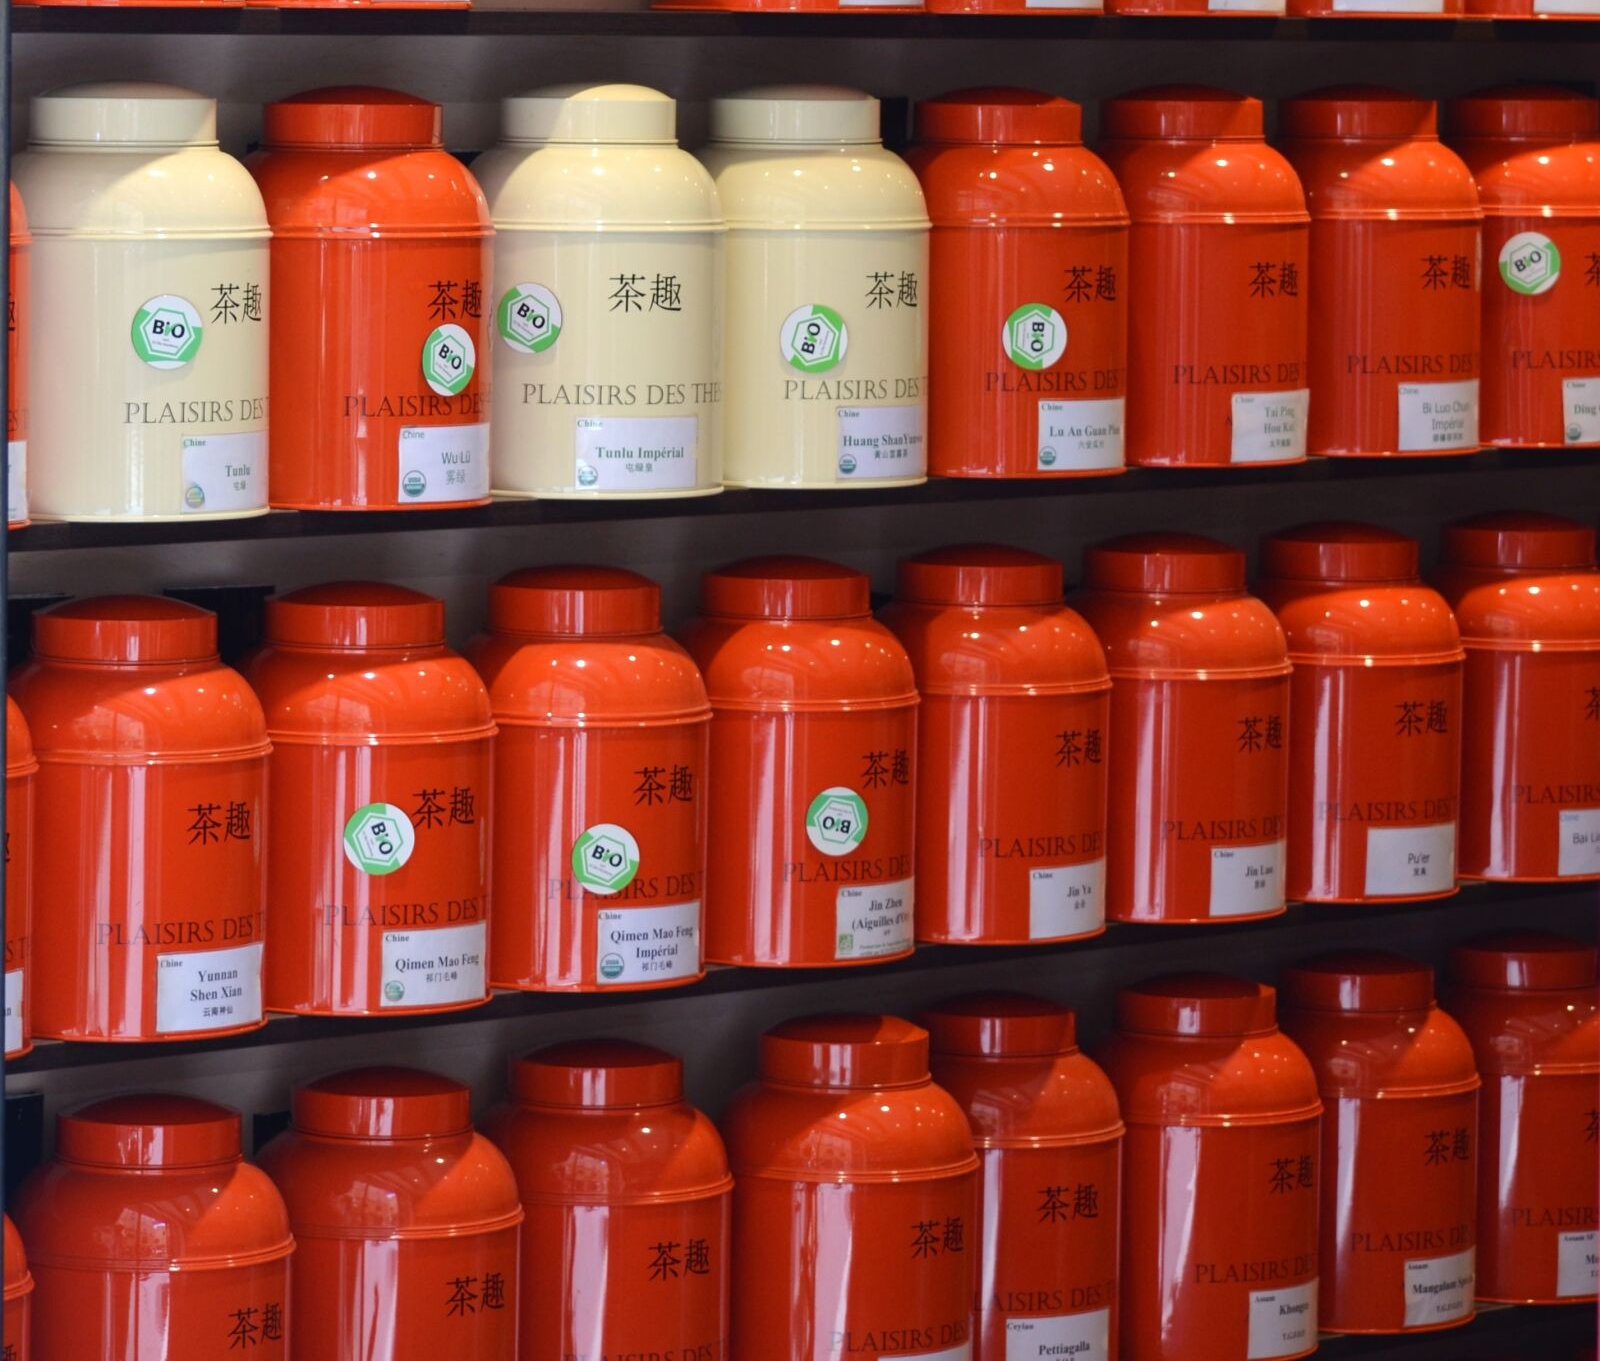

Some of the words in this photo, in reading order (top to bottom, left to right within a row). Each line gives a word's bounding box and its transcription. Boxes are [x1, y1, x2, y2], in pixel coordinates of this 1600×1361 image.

[1248, 261, 1299, 299] 茶趣
[1422, 255, 1470, 290] 茶趣
[608, 273, 683, 313] 茶趣
[1064, 265, 1116, 302] 茶趣
[210, 283, 262, 324] 茶趣
[428, 280, 482, 321] 茶趣
[1173, 365, 1271, 385] PLAISIRS
[1347, 355, 1443, 375] PLAISIRS
[783, 378, 887, 400] PLAISIRS
[985, 371, 1087, 392] PLAISIRS
[522, 384, 636, 406] PLAISIRS
[124, 399, 234, 424] PLAISIRS
[344, 393, 453, 418] PLAISIRS
[838, 409, 860, 419] Chine
[1041, 402, 1063, 412] Chine
[402, 429, 425, 440] Chine
[843, 434, 879, 449] Huang
[1049, 425, 1064, 438] Lu
[1067, 425, 1082, 438] An
[183, 437, 206, 448] Chine
[441, 451, 458, 465] Wu
[595, 446, 633, 459] Tunlu
[638, 445, 684, 461] Impérial
[225, 463, 251, 478] Tunlu
[1237, 715, 1282, 752] 茶趣
[1056, 729, 1101, 768] 茶趣
[862, 749, 910, 790] 茶趣
[634, 765, 694, 806] 茶趣
[186, 801, 251, 845] 茶趣
[1214, 850, 1235, 859] Chine
[1407, 852, 1430, 866] Pu'er
[1032, 871, 1053, 880] Chine
[1245, 864, 1258, 878] Jin
[1067, 885, 1080, 898] Jin
[1081, 884, 1092, 896] Ya
[869, 899, 882, 913] Jin
[884, 897, 903, 911] Zhen
[598, 911, 622, 921] Chine
[852, 913, 892, 932] (Aiguilles
[95, 919, 215, 946] PLAISIRS
[386, 933, 410, 943] Chine
[610, 927, 650, 944] Qimen
[652, 927, 674, 941] Mao
[675, 924, 694, 941] Feng
[395, 955, 435, 972] Qimen
[438, 953, 460, 968] Mao
[462, 951, 480, 969] Feng
[636, 943, 679, 960] Impérial
[160, 958, 183, 968] Chine
[198, 967, 239, 983] Yunnan
[190, 987, 218, 1002] Shen
[221, 985, 243, 1000] Xian
[911, 1217, 964, 1259] 茶趣
[647, 1240, 711, 1281] 茶趣
[446, 1272, 505, 1318] 茶趣
[228, 1302, 282, 1350] 茶趣
[1038, 1341, 1090, 1357] Pettiagalla
